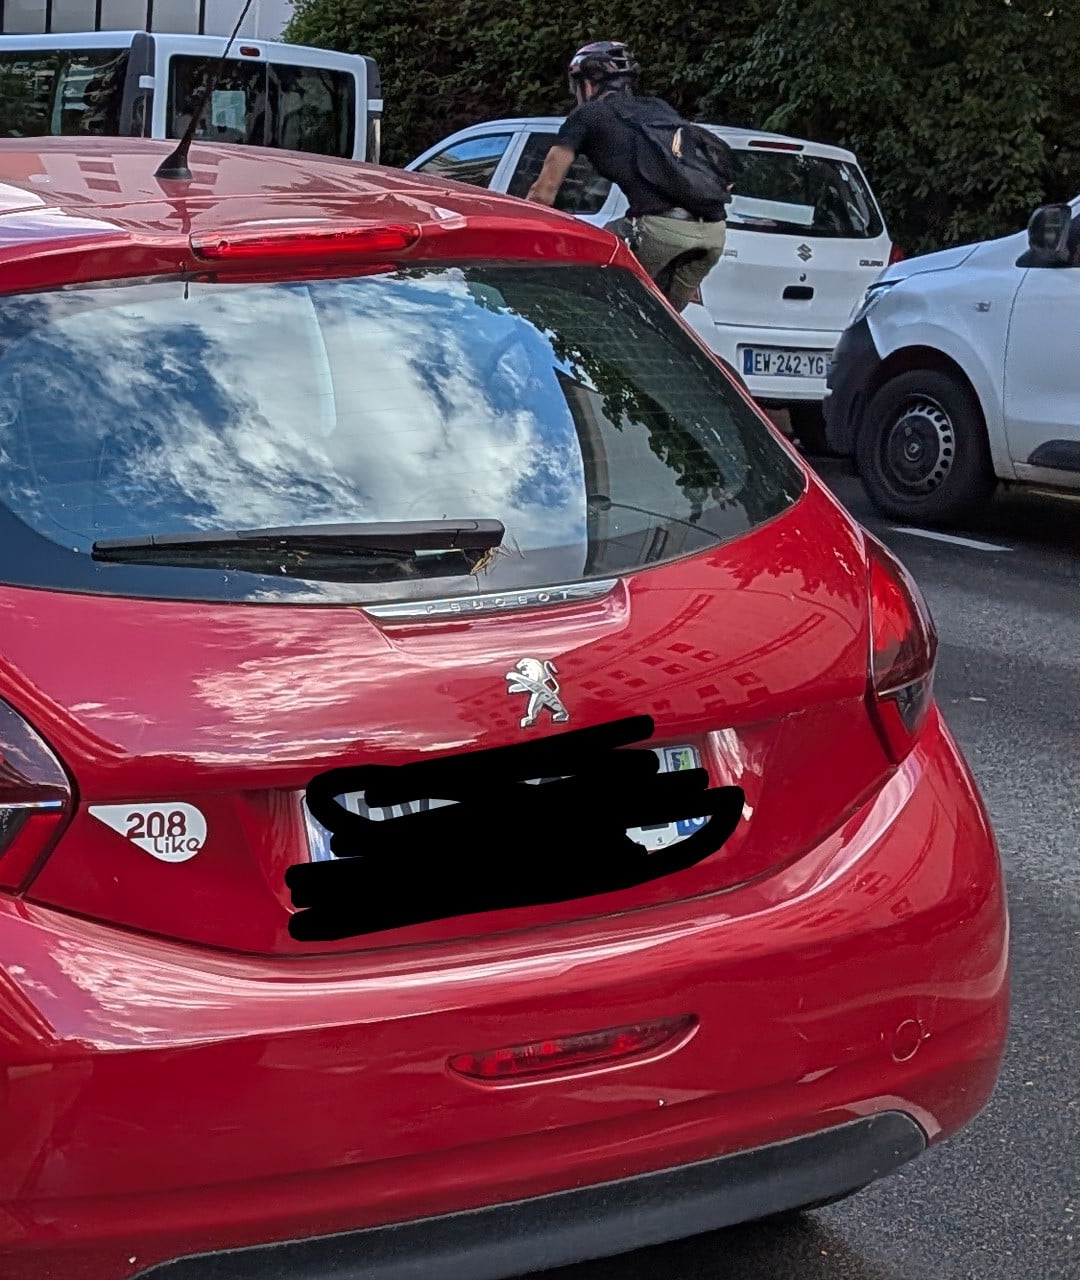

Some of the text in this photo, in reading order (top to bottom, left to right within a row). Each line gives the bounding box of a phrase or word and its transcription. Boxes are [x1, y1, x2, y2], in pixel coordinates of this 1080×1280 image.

[755, 353, 824, 375] EW-242-YG
[426, 590, 571, 613] PEUGEOT
[126, 810, 187, 838] 208
